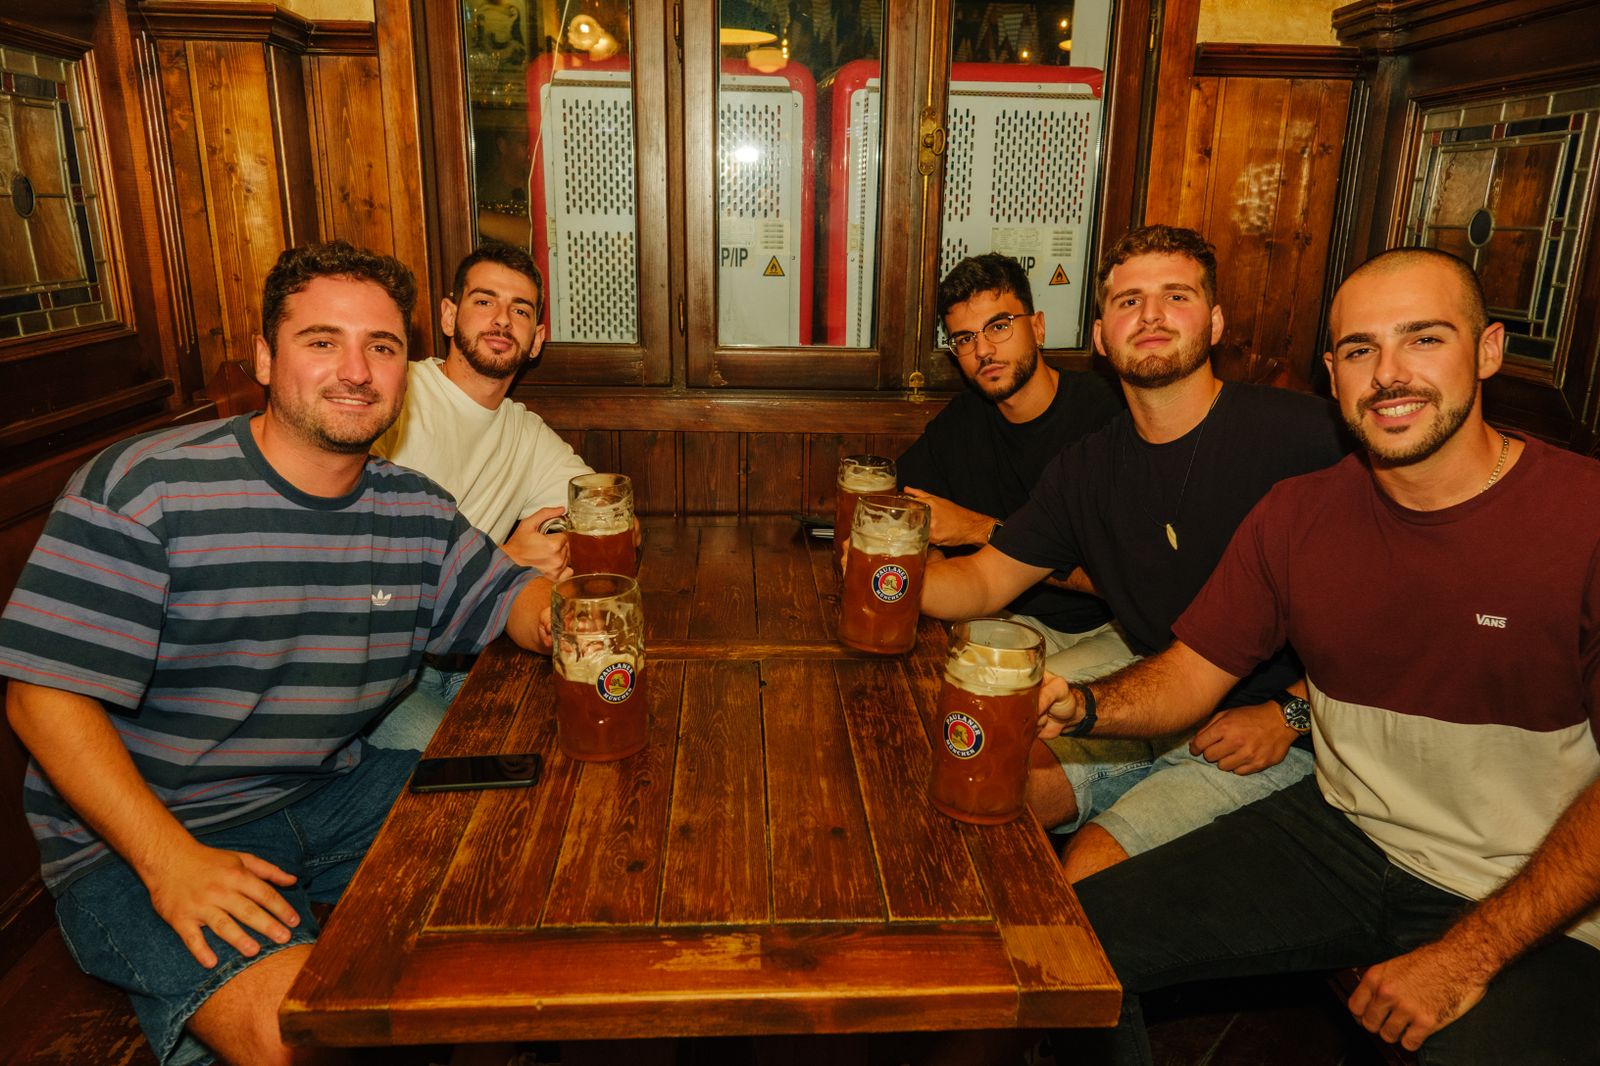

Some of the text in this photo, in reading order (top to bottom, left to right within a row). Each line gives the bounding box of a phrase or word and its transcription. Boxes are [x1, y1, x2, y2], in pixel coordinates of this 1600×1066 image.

[876, 566, 907, 580] PAULANER
[1475, 613, 1508, 629] VANS
[599, 663, 634, 681] PAULANER
[946, 714, 981, 736] PAULANER
